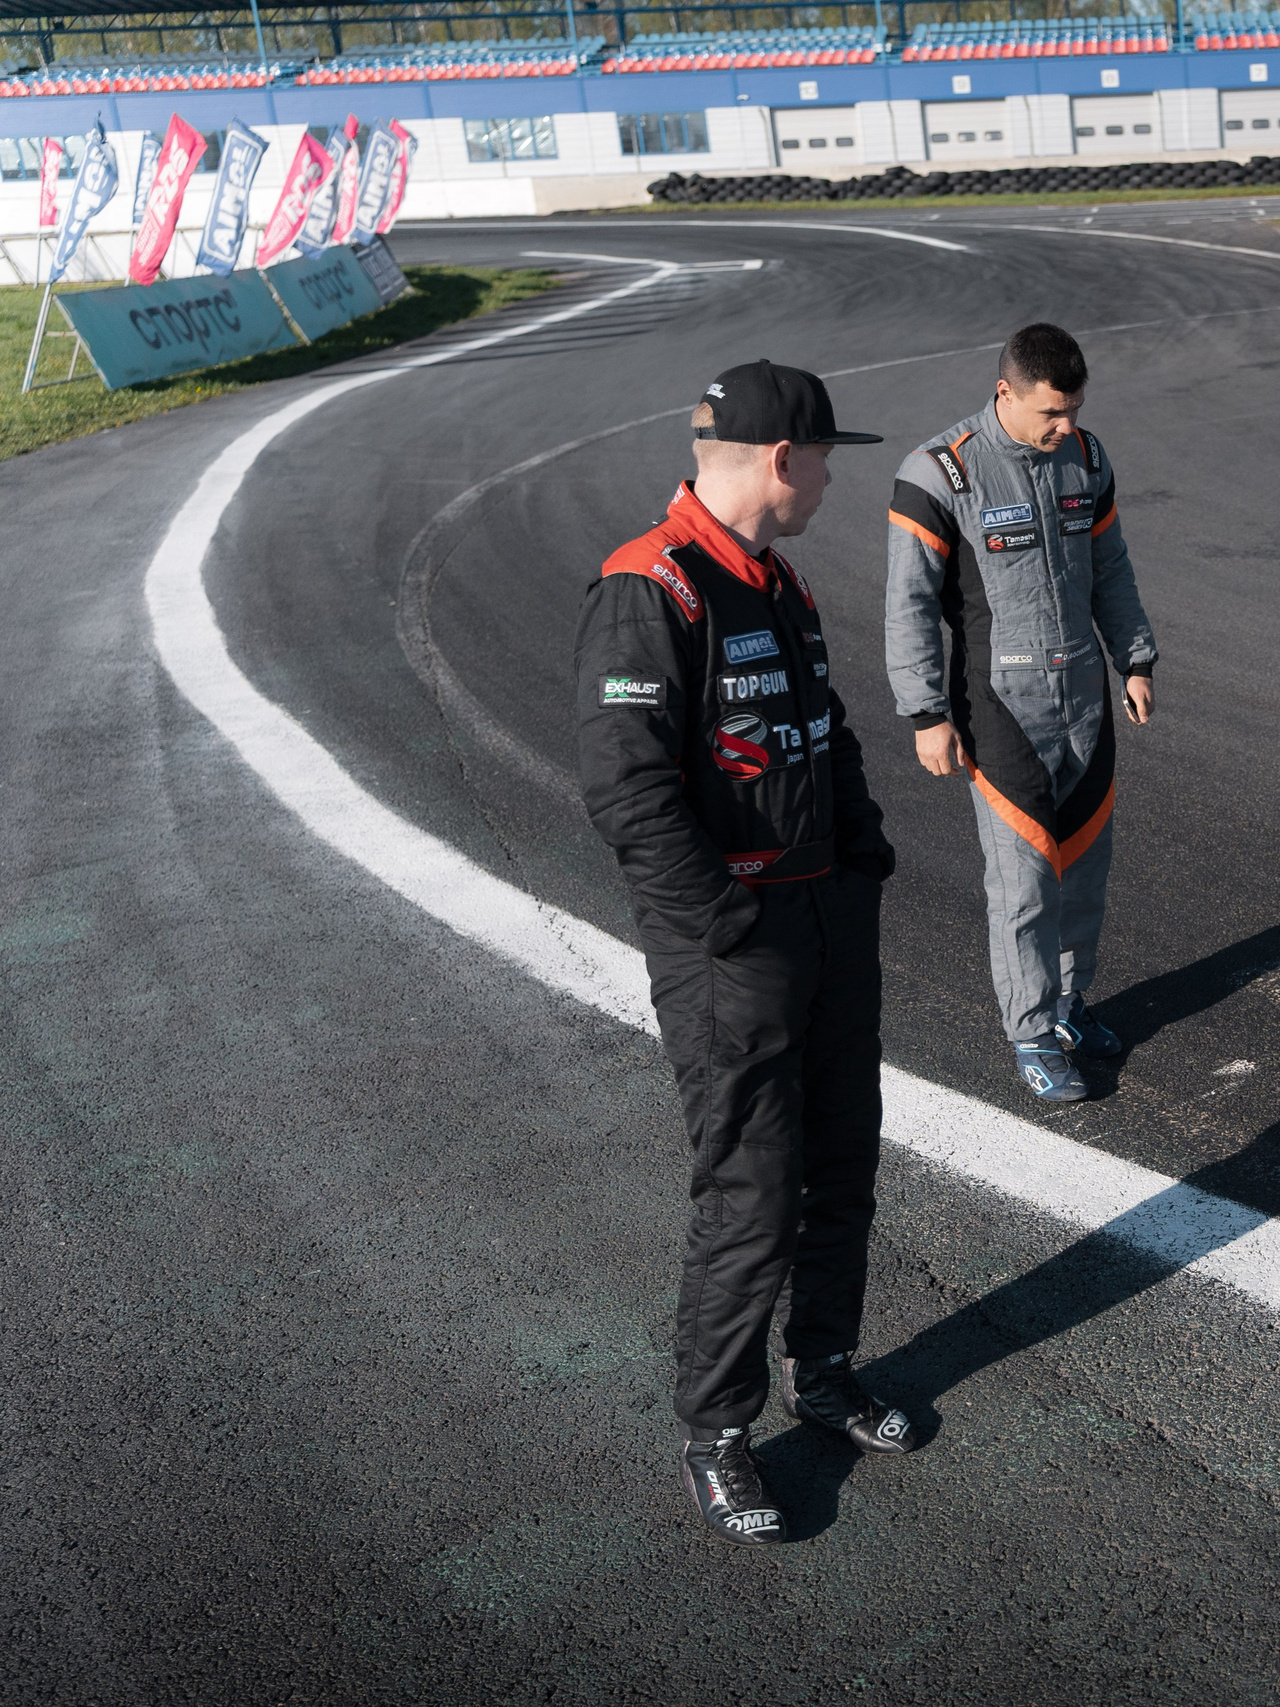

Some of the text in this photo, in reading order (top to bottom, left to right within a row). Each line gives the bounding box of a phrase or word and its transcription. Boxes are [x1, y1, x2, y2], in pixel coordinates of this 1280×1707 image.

[148, 134, 190, 226] RDS
[281, 151, 324, 224] RDS
[358, 143, 391, 228] AIMOL
[212, 145, 249, 256] AIMOL
[938, 453, 964, 490] sparco
[984, 507, 1031, 525] AIMOL
[651, 564, 698, 610] sparco
[730, 637, 775, 659] AIMOL
[1000, 655, 1033, 664] sparco
[604, 680, 660, 696] EXHAUST
[728, 861, 764, 874] arco
[726, 1512, 778, 1532] OMP
